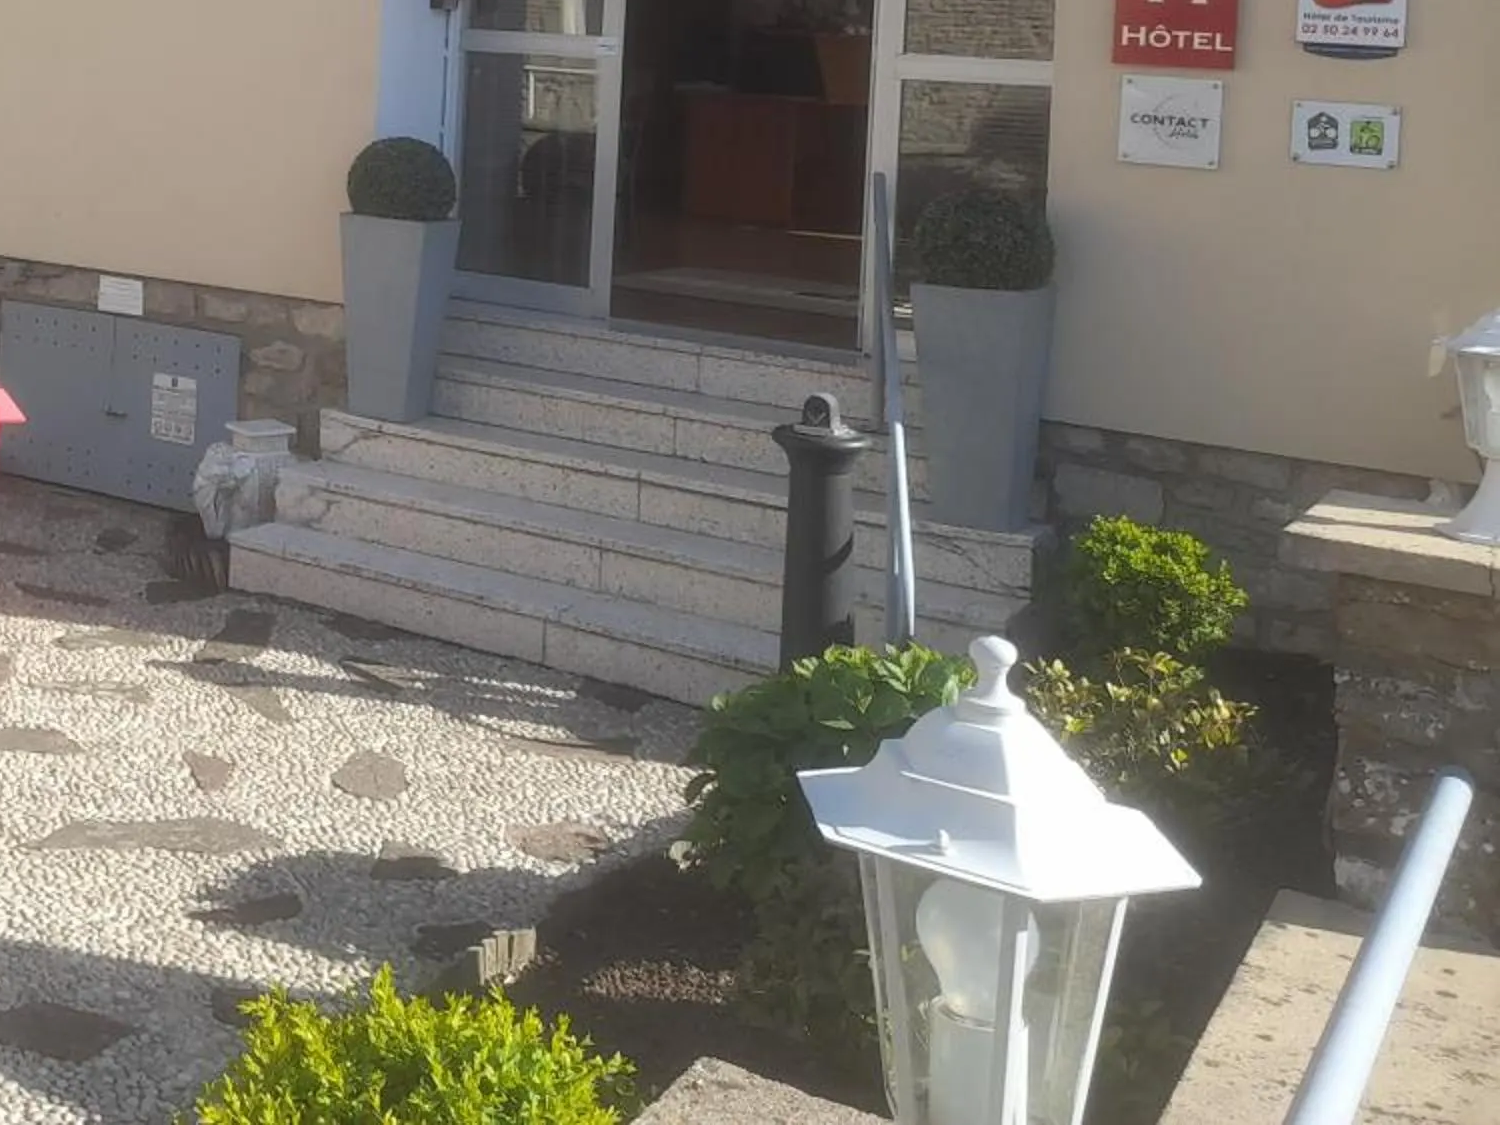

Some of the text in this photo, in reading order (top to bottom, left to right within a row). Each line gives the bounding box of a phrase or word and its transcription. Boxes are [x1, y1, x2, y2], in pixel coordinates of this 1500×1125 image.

[1121, 23, 1233, 52] HÔTEL
[1301, 24, 1317, 34] 02
[1364, 26, 1378, 36] 99
[1383, 26, 1399, 38] 64
[1130, 112, 1209, 129] CONTACT
